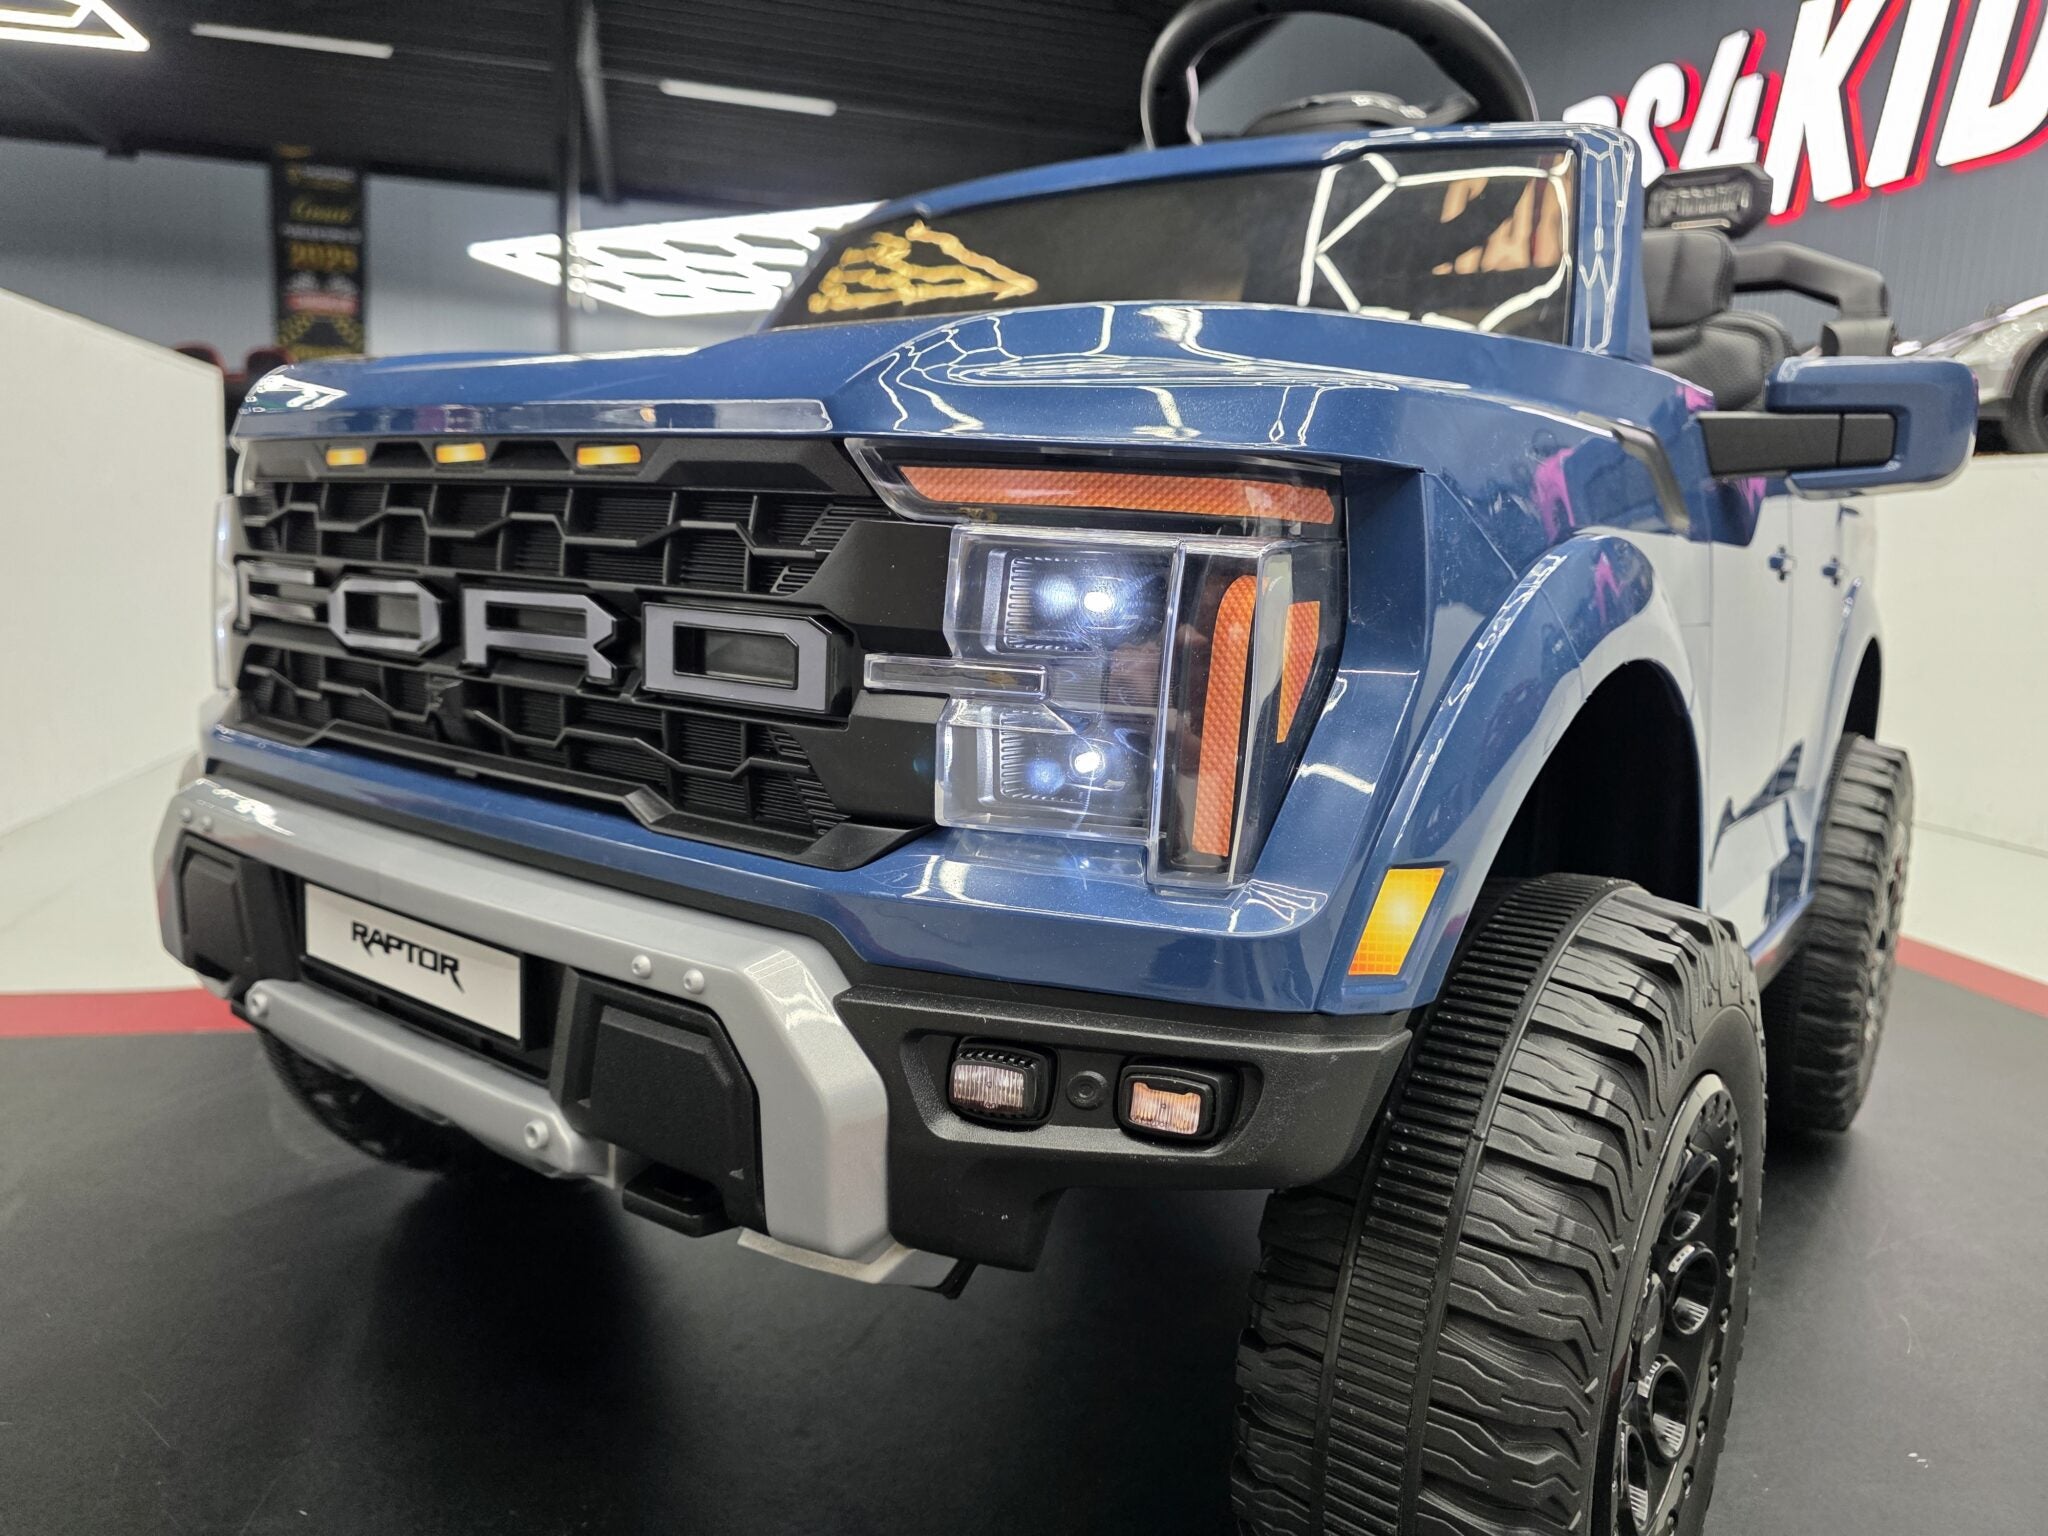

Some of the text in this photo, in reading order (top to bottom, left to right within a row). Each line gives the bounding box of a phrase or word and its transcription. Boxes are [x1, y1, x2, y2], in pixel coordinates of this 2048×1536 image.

[1562, 0, 2048, 216] S4KID
[238, 560, 827, 714] FORD
[352, 920, 464, 994] RAPTOR
